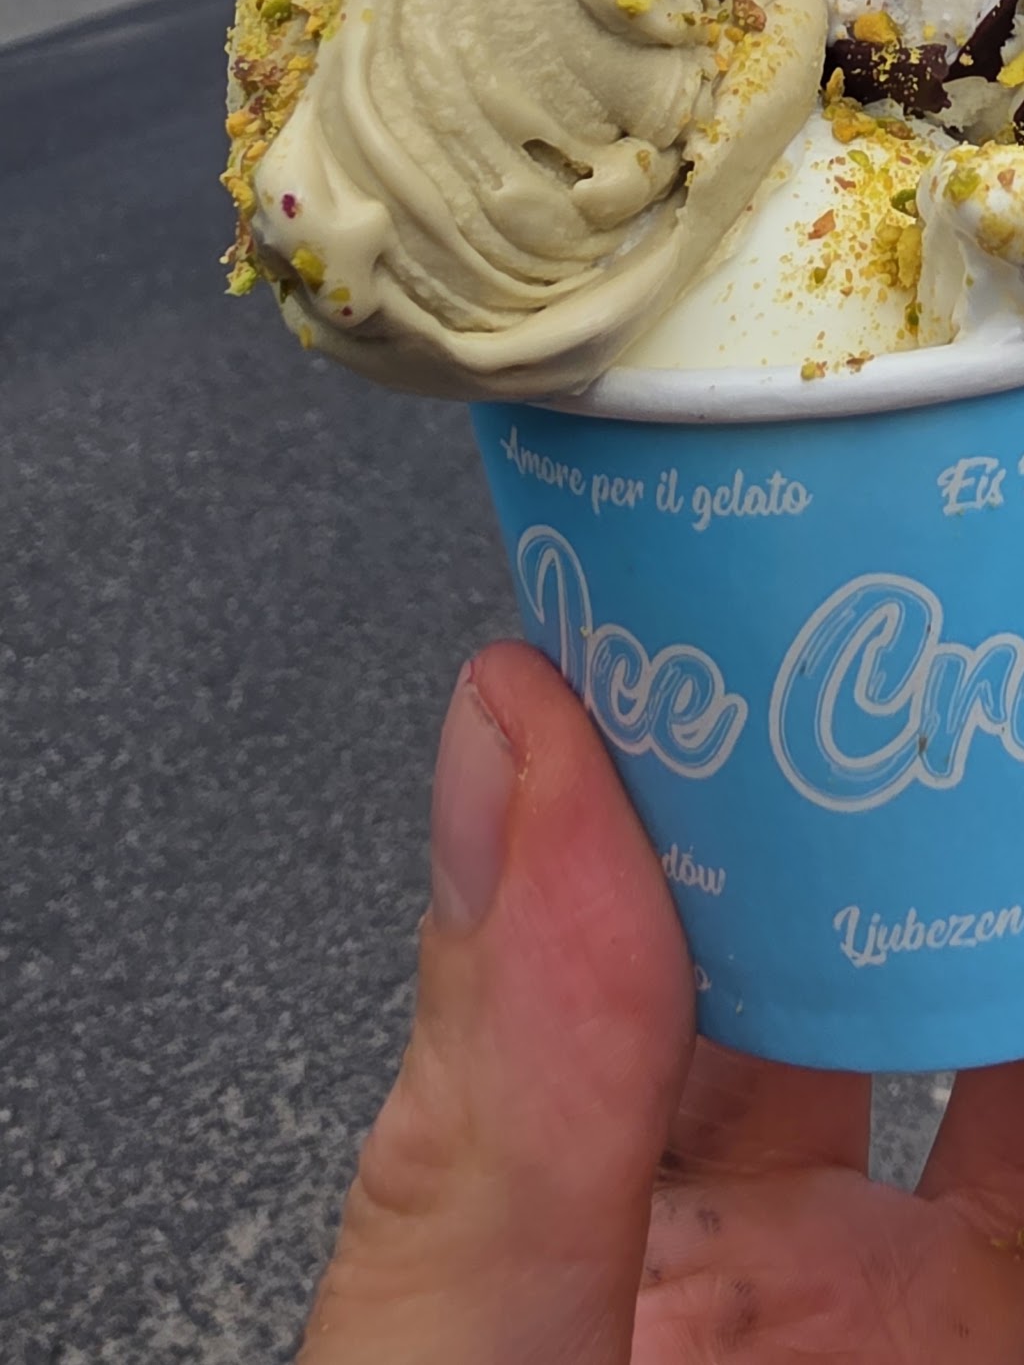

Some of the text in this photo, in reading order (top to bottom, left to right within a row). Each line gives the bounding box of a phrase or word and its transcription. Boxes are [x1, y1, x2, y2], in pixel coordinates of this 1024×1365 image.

[500, 425, 814, 532] Amore per il gelato
[937, 455, 1003, 516] Eis
[517, 524, 748, 779] Ice
[661, 843, 726, 896] dów
[833, 904, 1024, 968] Ljubezen
